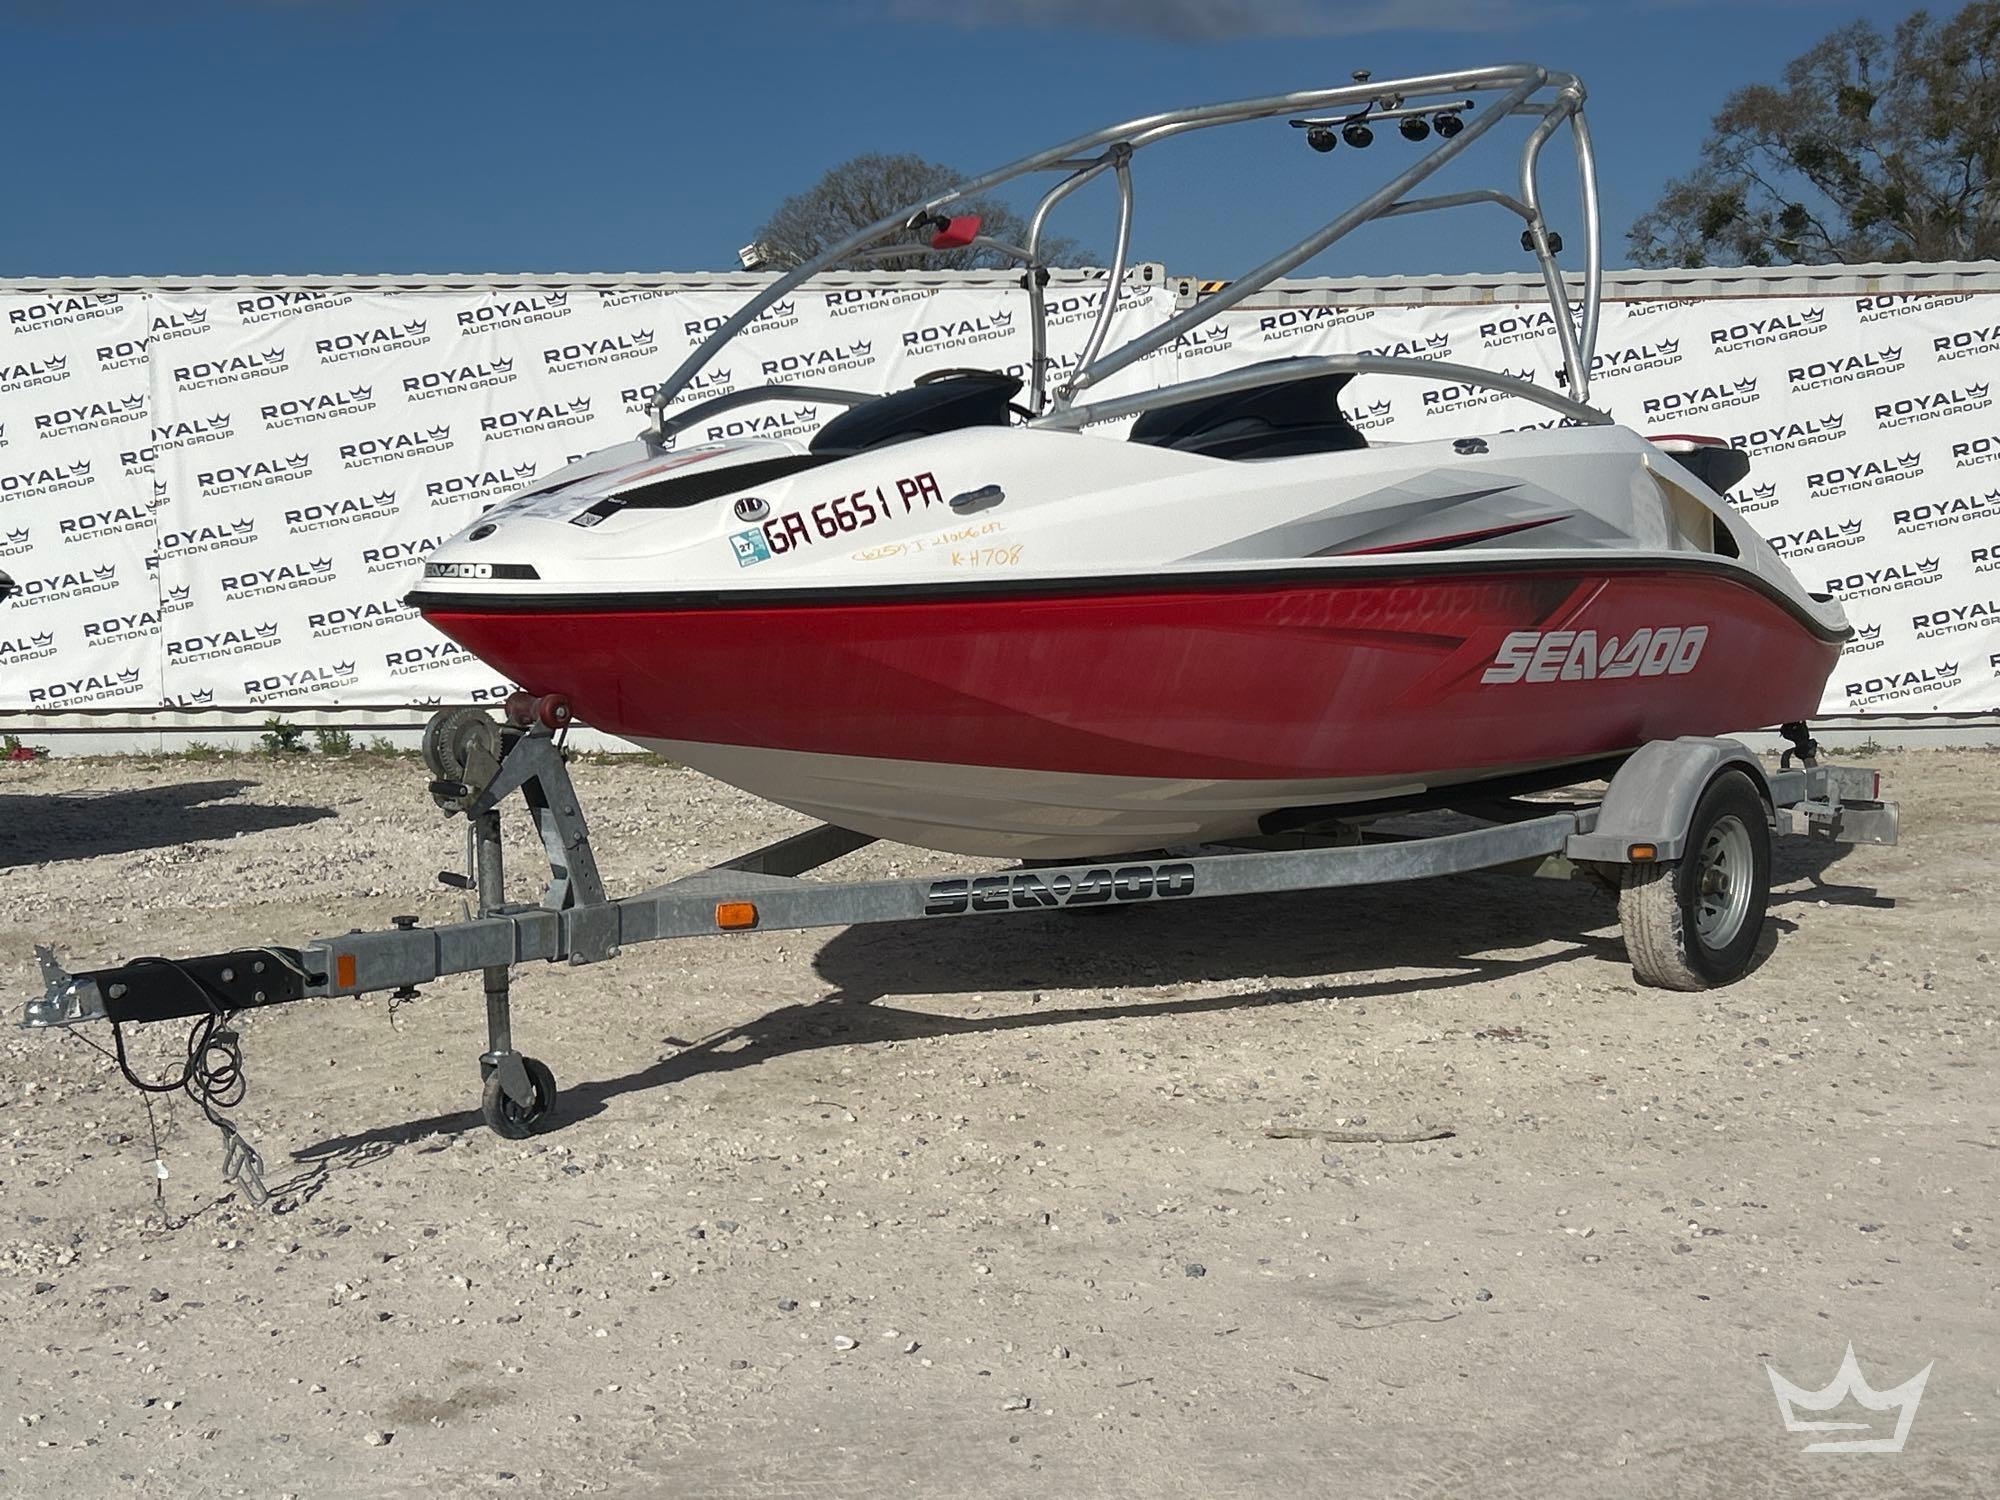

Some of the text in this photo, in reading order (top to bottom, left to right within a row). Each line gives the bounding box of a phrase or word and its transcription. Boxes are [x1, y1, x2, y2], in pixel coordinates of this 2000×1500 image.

[9, 296, 98, 324] ROYAL
[242, 297, 352, 325] AUCTION GROUP
[457, 298, 546, 326] ROYAL
[603, 290, 662, 308] AUCTION
[830, 299, 889, 317] AUCTION
[1628, 299, 1688, 318] AUCTION
[15, 306, 123, 334] AUCTION GROUP
[462, 308, 571, 336] AUCTION GROUP
[752, 318, 798, 333] GROUP
[1264, 311, 1374, 341] AUCTION GROUP
[1860, 304, 1922, 323] AUCTION
[162, 324, 211, 341] GROUP
[316, 327, 405, 354] ROYAL
[903, 318, 990, 346] ROYAL
[907, 328, 1015, 356] AUCTION GROUP
[1484, 329, 1544, 348] AUCTION
[1711, 315, 1801, 344] ROYAL
[1715, 324, 1827, 354] AUCTION GROUP
[321, 337, 430, 364] AUCTION GROUP
[544, 336, 632, 364] ROYAL
[548, 346, 658, 374] AUCTION GROUP
[762, 347, 850, 375] ROYAL
[1185, 341, 1233, 358] GROUP
[1634, 355, 1682, 371] GROUP
[1937, 343, 1999, 362] AUCTION
[24, 372, 70, 387] GROUP
[174, 355, 263, 382] ROYAL
[179, 365, 288, 392] AUCTION GROUP
[403, 364, 491, 392] ROYAL
[766, 357, 875, 385] AUCTION GROUP
[1788, 353, 1879, 383] ROYAL
[1792, 363, 1905, 393] AUCTION GROUP
[408, 374, 517, 402] AUCTION GROUP
[688, 386, 734, 401] GROUP
[1643, 385, 1734, 413] ROYAL
[34, 401, 122, 429] ROYAL
[261, 392, 350, 420] ROYAL
[266, 403, 376, 430] AUCTION GROUP
[480, 404, 569, 431] ROYAL
[1427, 397, 1487, 416] AUCTION
[1648, 394, 1760, 424] AUCTION GROUP
[1875, 390, 1966, 419] ROYAL
[1879, 399, 1992, 430] AUCTION GROUP
[40, 411, 147, 439] AUCTION GROUP
[187, 430, 234, 445] GROUP
[485, 414, 594, 441] AUCTION GROUP
[707, 413, 795, 441] ROYAL
[774, 423, 821, 439] GROUP
[1731, 421, 1820, 450] ROYAL
[1798, 431, 1846, 446] GROUP
[339, 432, 428, 459] ROYAL
[344, 442, 454, 469] AUCTION GROUP
[49, 477, 94, 492] GROUP
[197, 460, 286, 487] ROYAL
[203, 470, 312, 497] AUCTION GROUP
[426, 469, 515, 496] ROYAL
[1807, 460, 1897, 488] ROYAL
[1811, 469, 1924, 498] AUCTION GROUP
[285, 497, 374, 524] ROYAL
[431, 489, 490, 506] AUCTION
[1893, 496, 1985, 525] ROYAL
[59, 506, 146, 534] ROYAL
[290, 507, 399, 534] AUCTION GROUP
[762, 472, 943, 555] GA 6651 PA
[1898, 516, 1959, 535] AUCTION
[65, 526, 122, 543] AUCTION
[158, 525, 232, 552] OYAL
[211, 535, 258, 550] GROUP
[1817, 536, 1865, 552] GROUP
[221, 564, 310, 591] ROYAL
[226, 574, 336, 601] AUCTION GROUP
[1826, 565, 1917, 593] ROYAL
[1894, 574, 1942, 590] GROUP
[12, 581, 119, 609] AUCTION GROUP
[84, 610, 161, 637] ROYA
[308, 601, 397, 628] ROYAL
[313, 611, 419, 638] AUCTION GROUP
[89, 630, 147, 647] AUCTION
[167, 629, 255, 656] ROYAL
[1917, 621, 1977, 639] AUCTION
[10, 648, 57, 663] GROUP
[171, 639, 281, 666] AUCTION GROUP
[391, 659, 450, 675] AUCTION
[29, 675, 117, 702] ROYAL
[97, 684, 143, 699] GROUP
[244, 668, 332, 694] ROYAL
[250, 677, 358, 704] AUCTION GROUP
[1846, 669, 1936, 697] ROYAL
[1850, 678, 1961, 707] AUCTION GROUP
